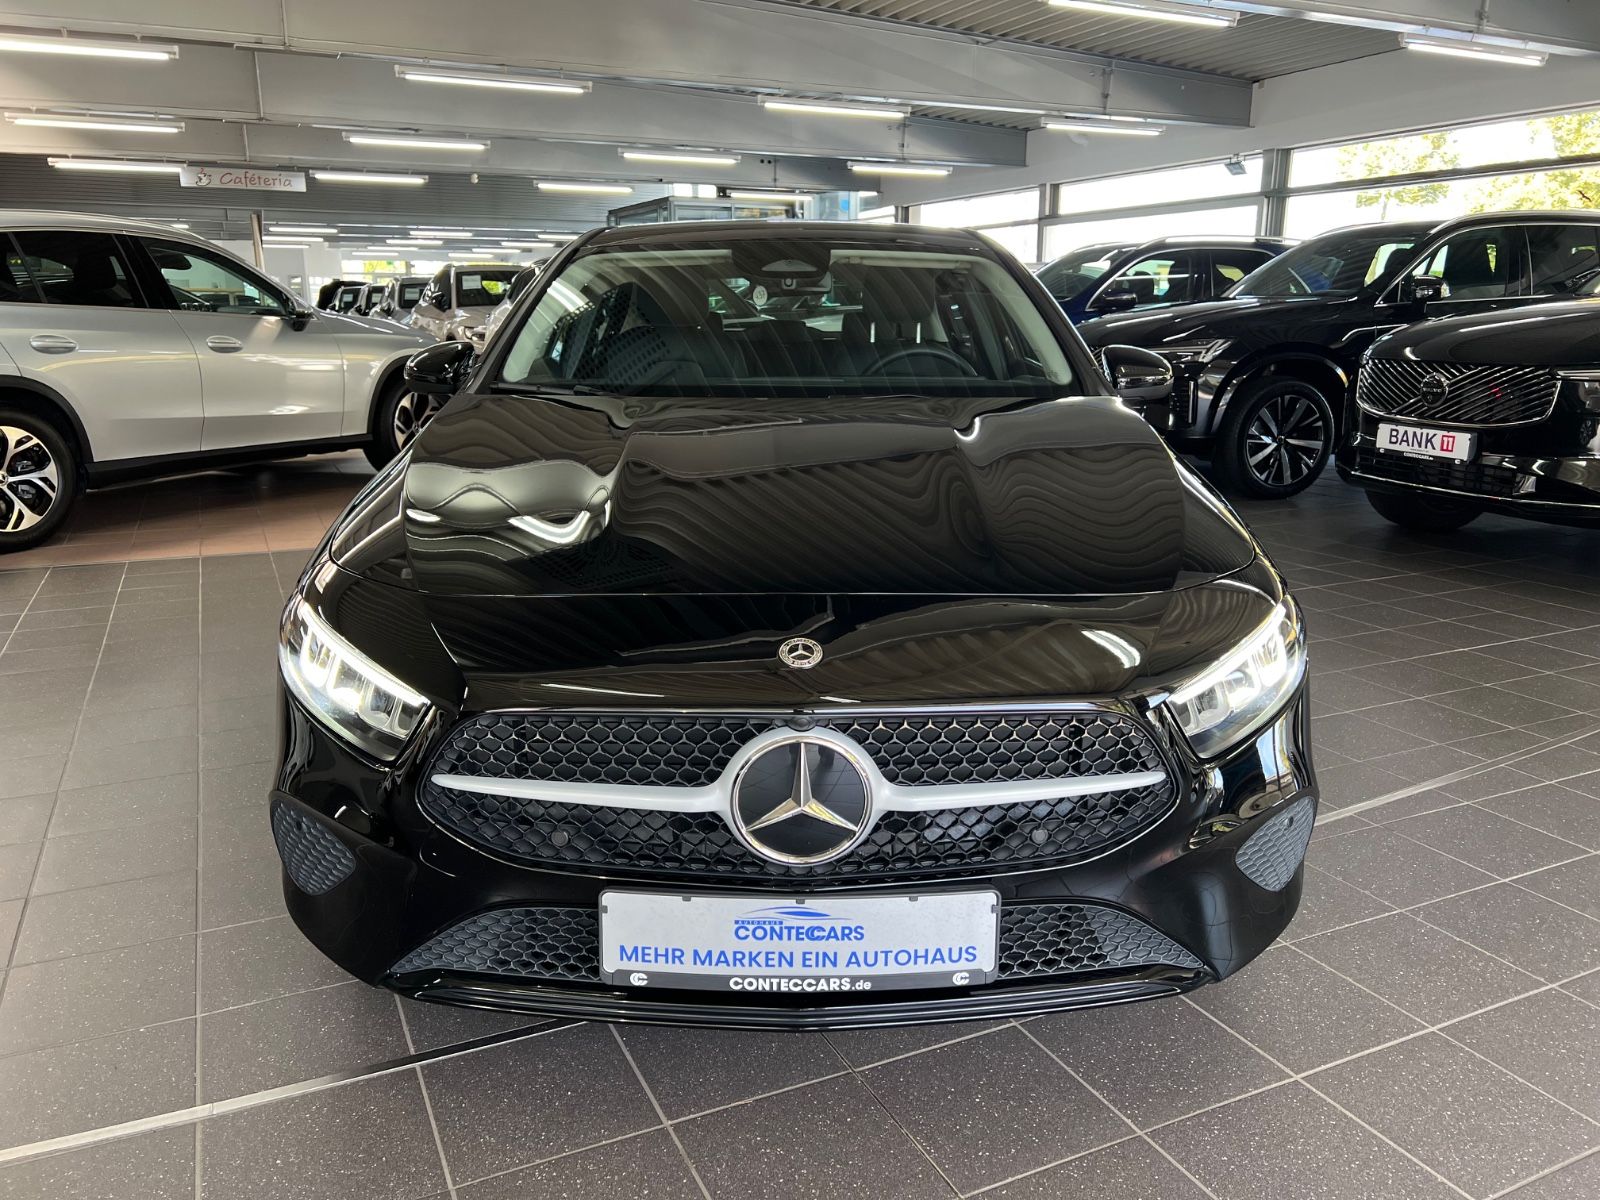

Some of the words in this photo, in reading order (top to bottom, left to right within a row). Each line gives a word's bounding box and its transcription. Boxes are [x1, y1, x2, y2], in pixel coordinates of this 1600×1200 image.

[1389, 428, 1438, 450] BANK
[1441, 436, 1454, 451] 11
[619, 945, 685, 965] MEHR
[693, 949, 794, 968] MARKEN
[802, 951, 838, 968] EIN
[845, 946, 977, 968] AUTOHAUS
[729, 977, 872, 992] CONTECCARS.de
